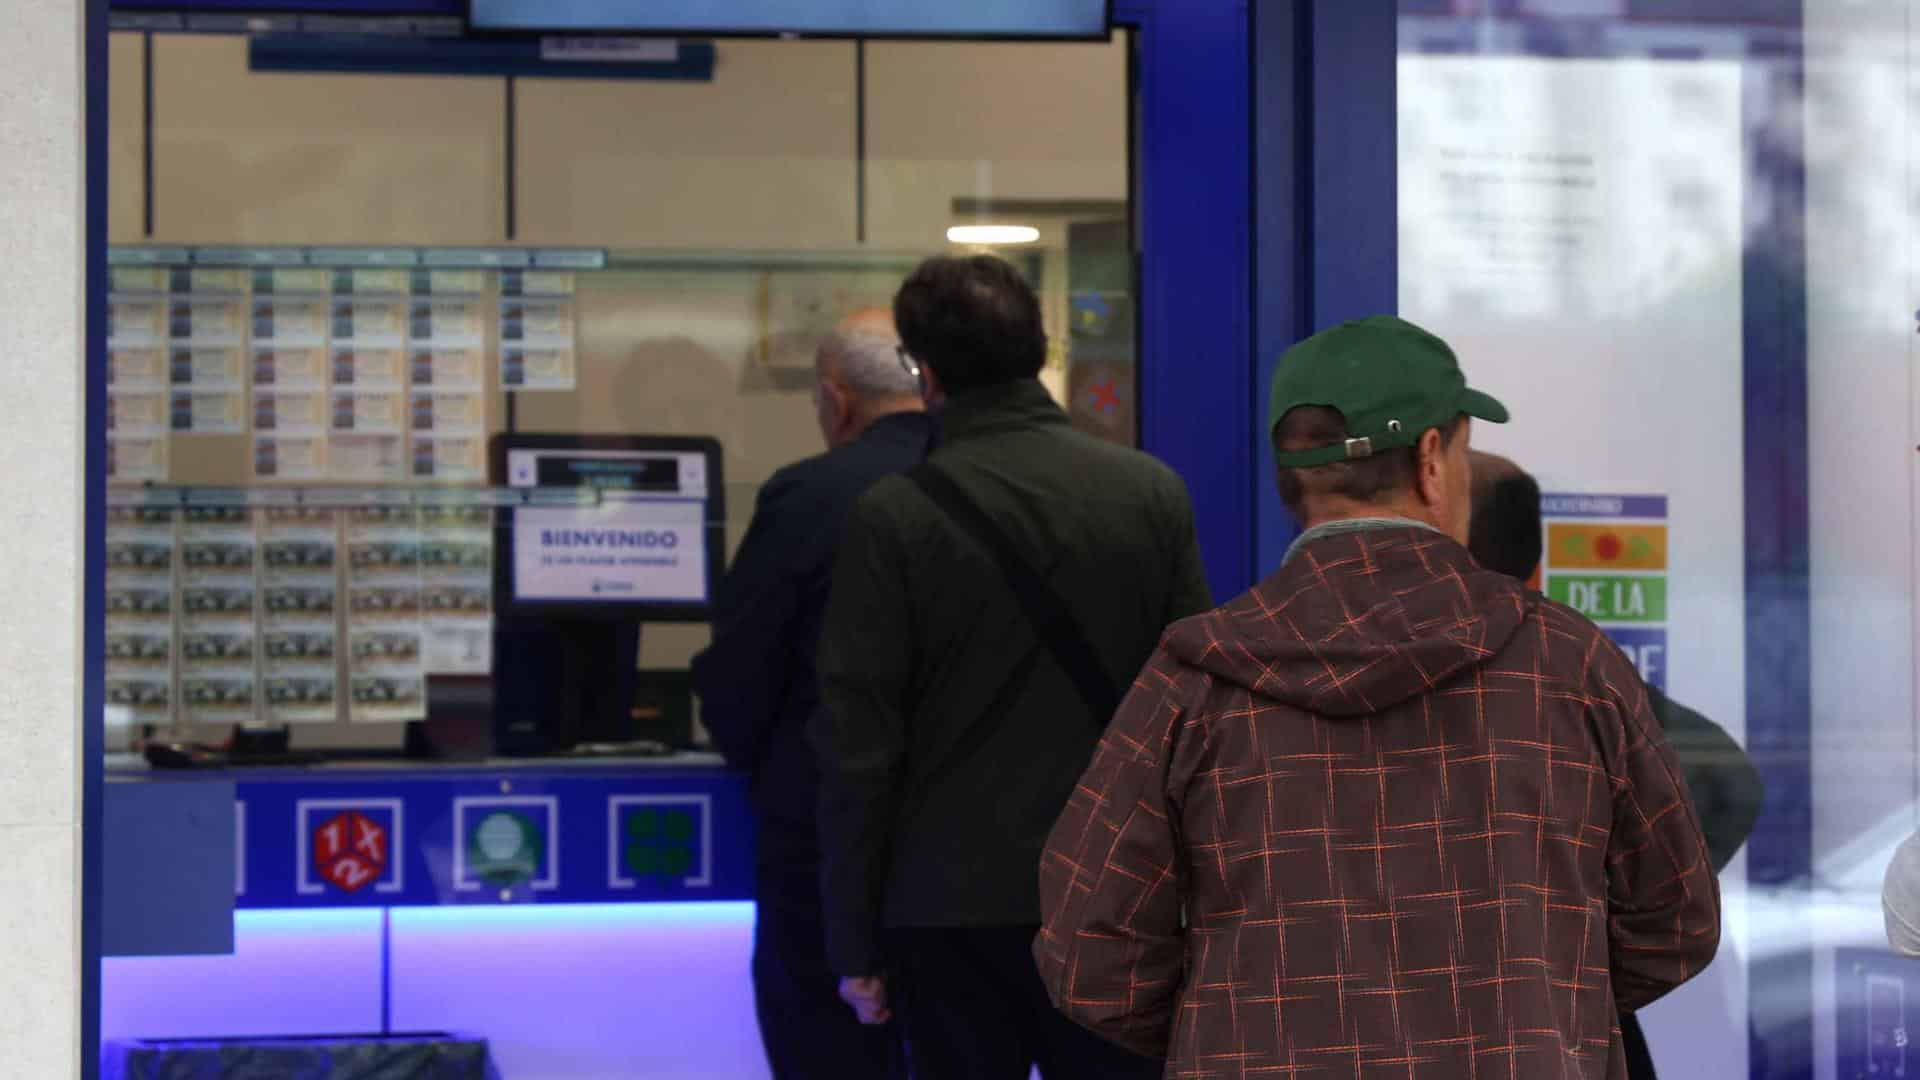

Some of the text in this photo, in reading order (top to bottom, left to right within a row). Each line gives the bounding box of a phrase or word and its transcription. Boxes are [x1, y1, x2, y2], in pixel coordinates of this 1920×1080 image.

[541, 529, 678, 548] BIENVENIDO
[1568, 580, 1647, 615] DE LA
